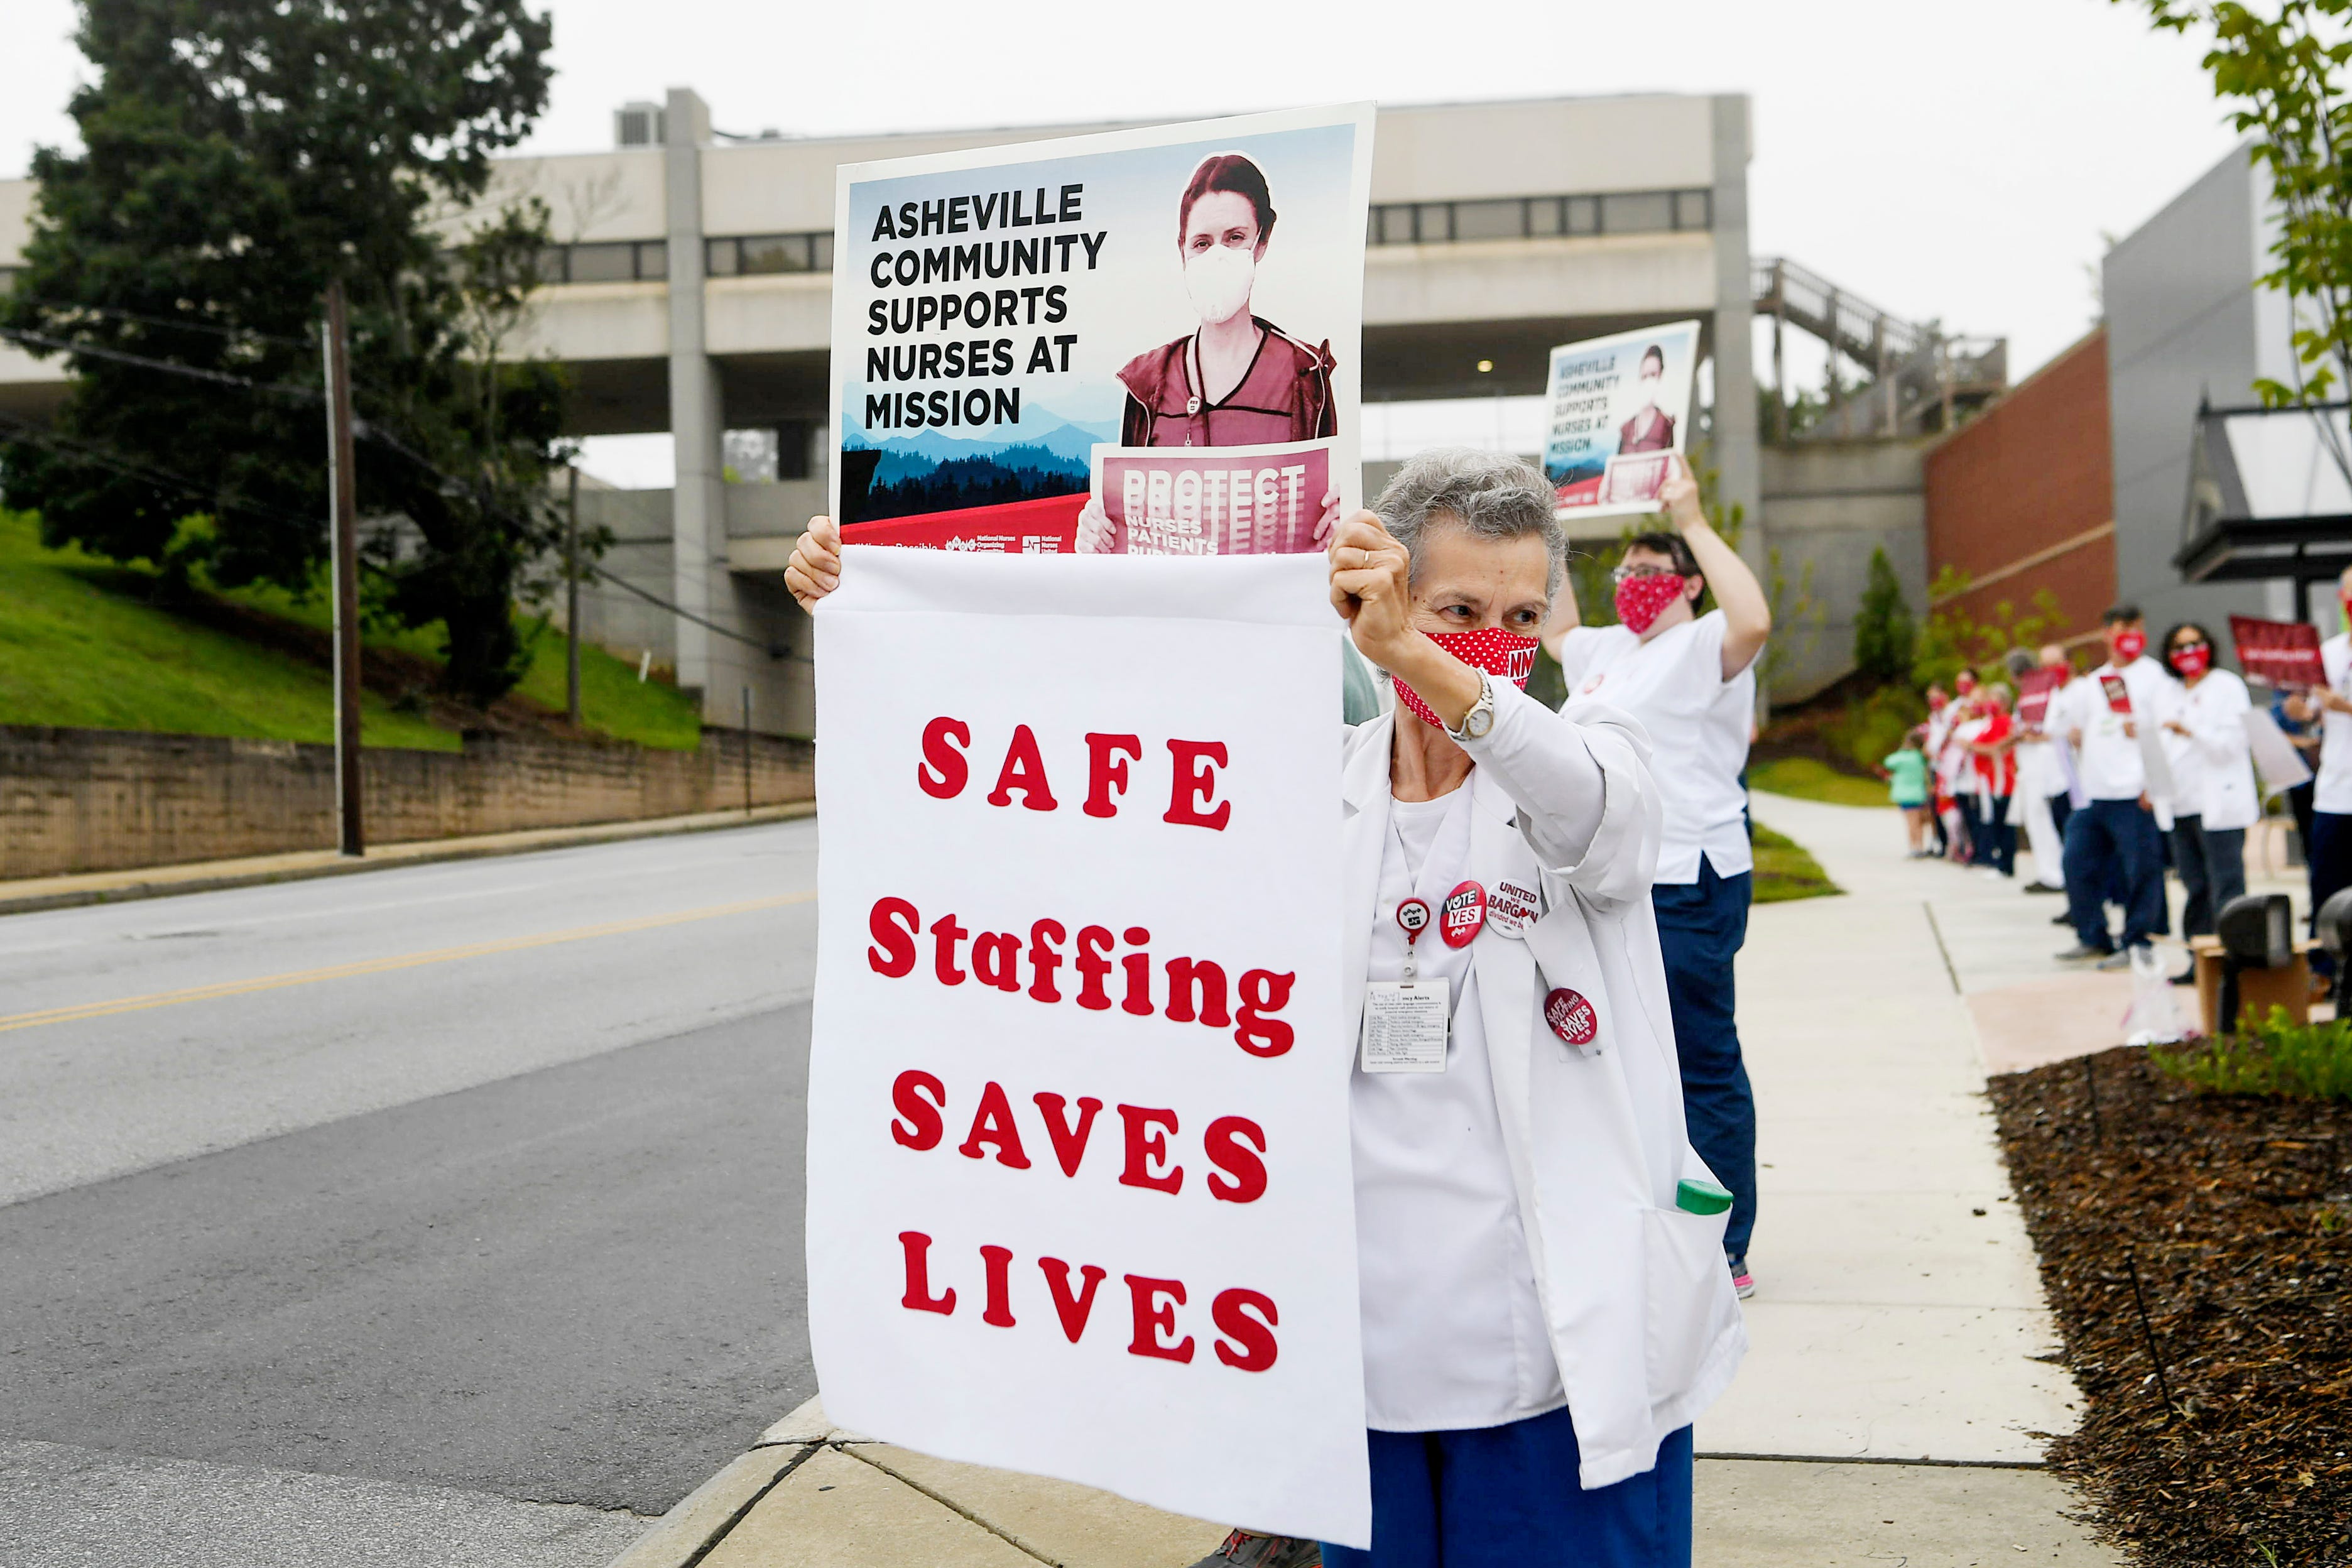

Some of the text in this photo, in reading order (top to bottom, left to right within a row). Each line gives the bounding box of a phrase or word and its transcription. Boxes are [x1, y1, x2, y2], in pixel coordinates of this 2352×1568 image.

[871, 183, 1083, 241] ASHEVILLE
[871, 231, 1108, 288] COMMUNITY
[867, 285, 1067, 335] SUPPORTS
[867, 334, 1077, 383] NURSES AT
[865, 387, 1020, 429] MISSION
[1123, 464, 1305, 505] PROTECT
[1124, 514, 1202, 535] NURSES
[1127, 527, 1219, 555] PATIENTS
[917, 716, 1231, 831] SAFE
[1446, 890, 1476, 911] VOTE
[1500, 881, 1537, 903] UNITED
[1451, 908, 1475, 924] YES
[868, 896, 1295, 1058] Staffing
[1547, 996, 1564, 1022] SAFE
[1560, 1005, 1591, 1031] SAVES
[1562, 1016, 1590, 1041] LIVES
[891, 1069, 1267, 1203] SAVES
[898, 1230, 1278, 1373] LIVES
